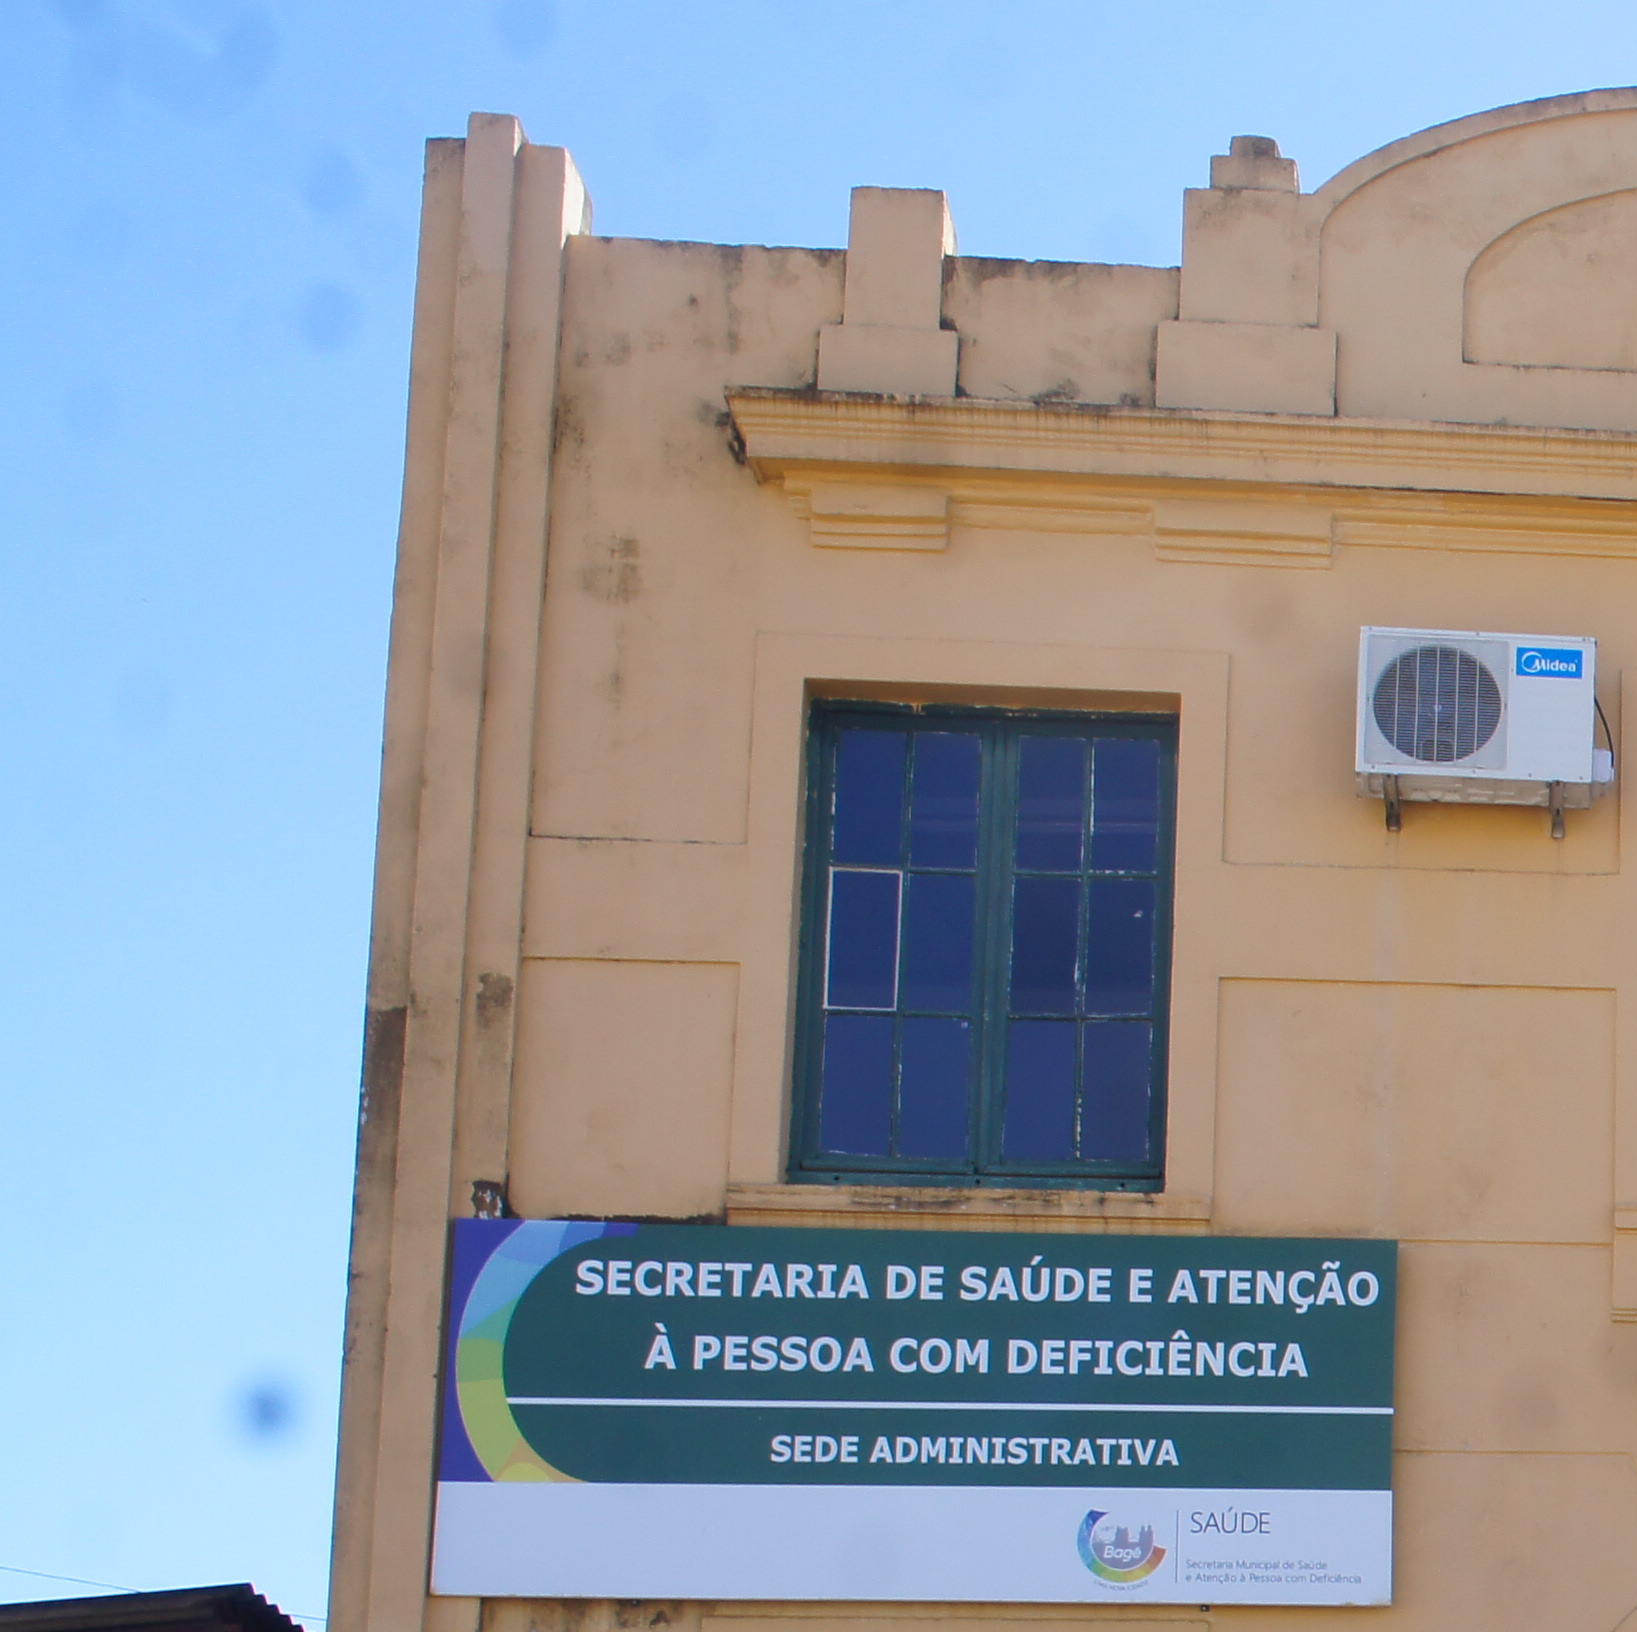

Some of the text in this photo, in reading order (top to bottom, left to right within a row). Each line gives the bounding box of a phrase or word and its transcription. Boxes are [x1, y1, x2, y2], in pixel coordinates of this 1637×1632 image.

[1524, 653, 1576, 673] Midea
[575, 1255, 1379, 1314] SECRETARIA DE SAÚDE E ATENÇÃO
[644, 1322, 1309, 1378] À PESSOA COM DEFICIÊNCIA
[770, 1435, 1179, 1466] SEDE ADMINISTRATIVA
[1190, 1506, 1271, 1535] SAÚDE
[1103, 1545, 1142, 1562] Bagé
[1186, 1559, 1328, 1571] Secretaria Municipal de Saúde
[1186, 1574, 1192, 1582] e
[1195, 1573, 1237, 1584] Atenção
[1249, 1573, 1282, 1584] Pessoa
[1285, 1575, 1307, 1584] com
[1309, 1573, 1362, 1584] Deficiência
